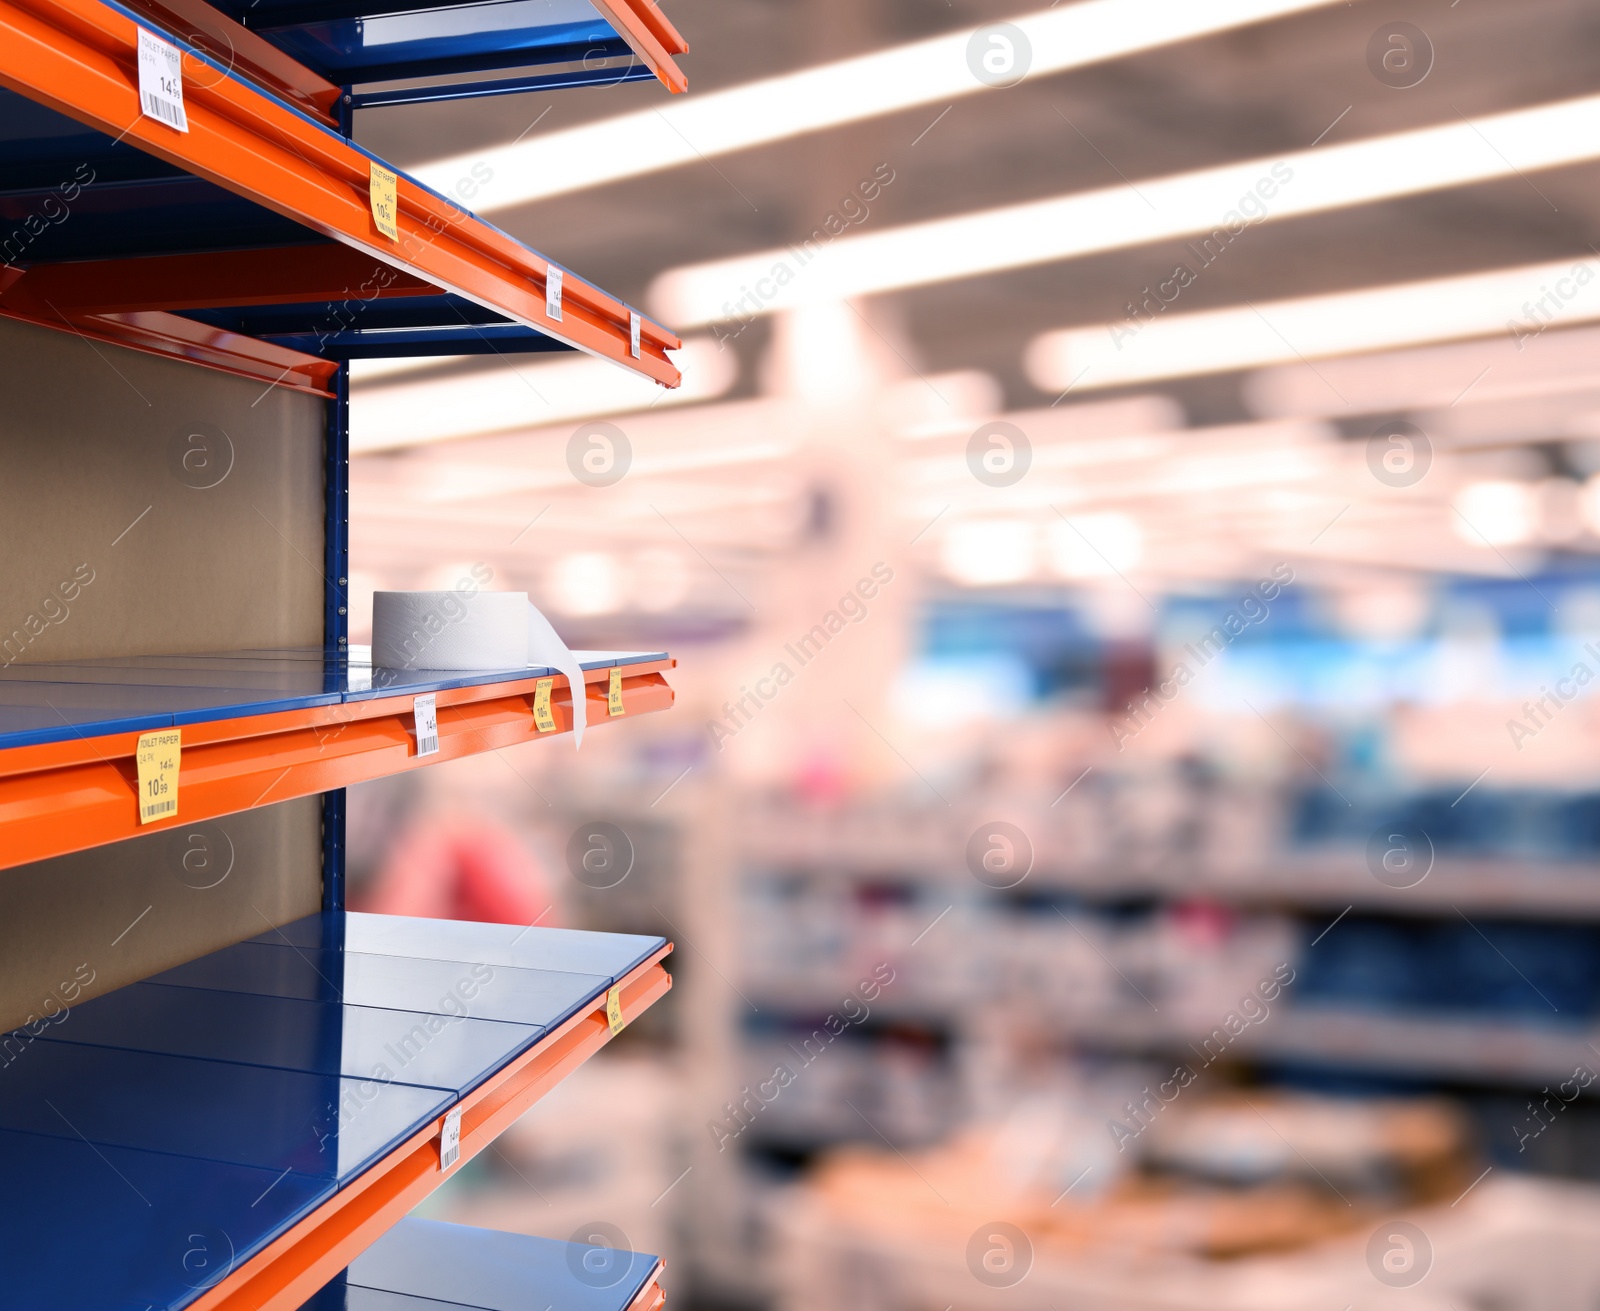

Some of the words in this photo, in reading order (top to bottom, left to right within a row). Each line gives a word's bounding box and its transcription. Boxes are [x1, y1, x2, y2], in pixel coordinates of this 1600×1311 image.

[141, 36, 161, 55] TOILET
[161, 48, 179, 63] PAPER
[383, 173, 395, 184] PAPER
[140, 738, 158, 749] TOILET
[158, 734, 179, 745] PAPER
[140, 754, 146, 764] 24
[147, 752, 154, 762] PK
